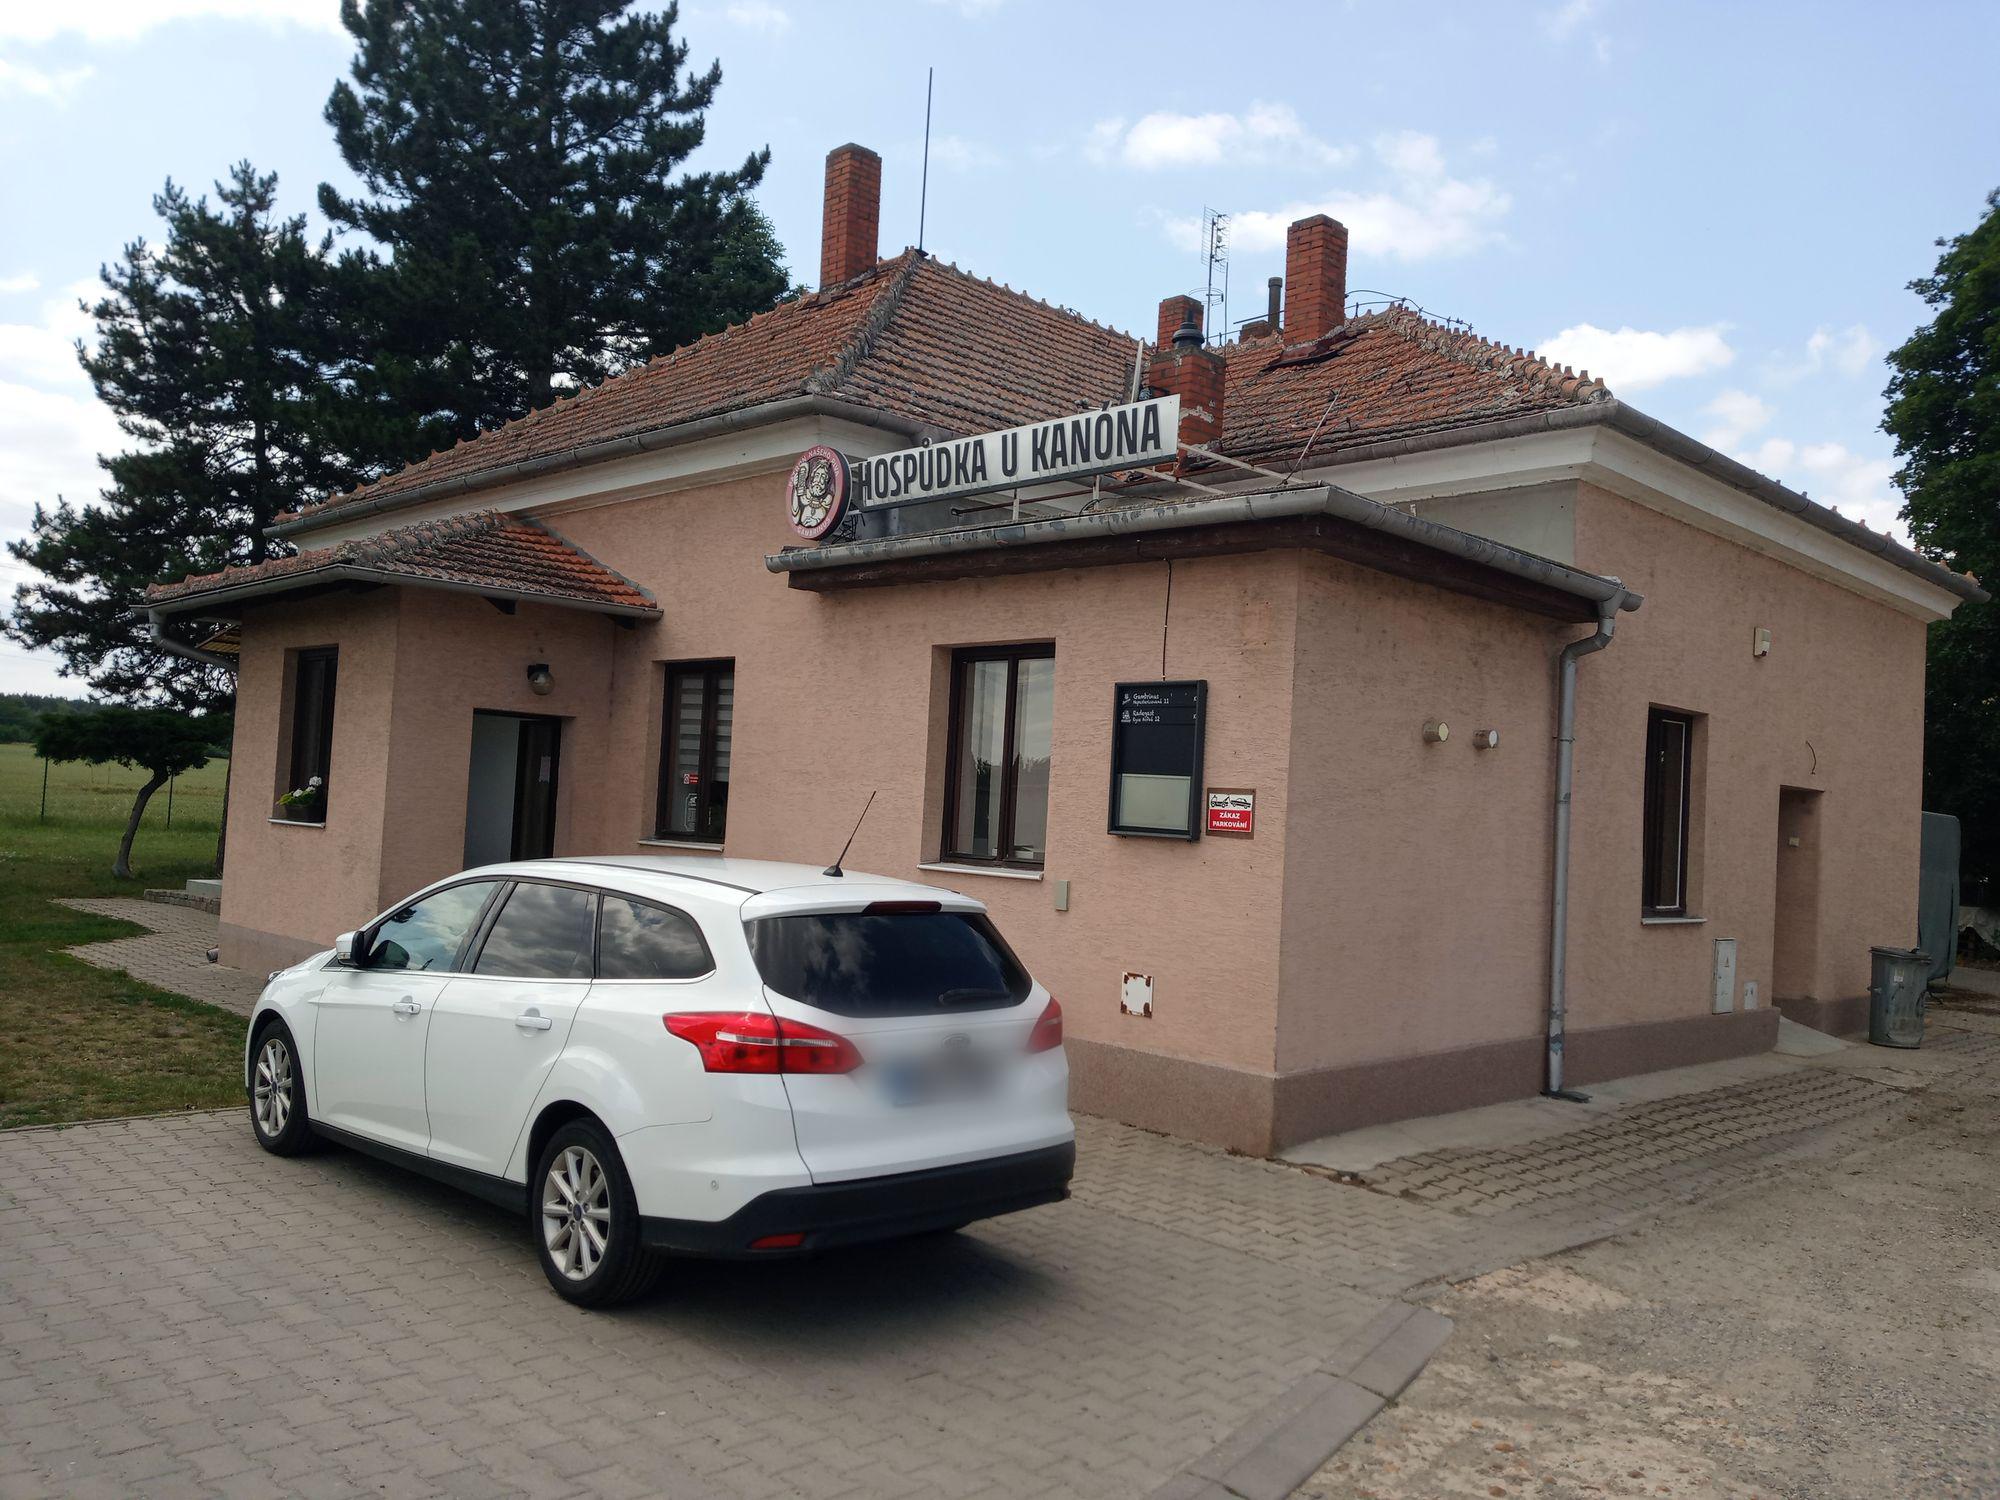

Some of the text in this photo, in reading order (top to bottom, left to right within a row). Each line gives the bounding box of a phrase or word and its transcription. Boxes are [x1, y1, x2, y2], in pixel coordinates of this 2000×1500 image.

[858, 400, 1162, 500] HOSPŮDKA U KANÓNA
[1219, 811, 1241, 820] ZÁKAZ
[1212, 820, 1248, 829] PARKOVÁNÍ
